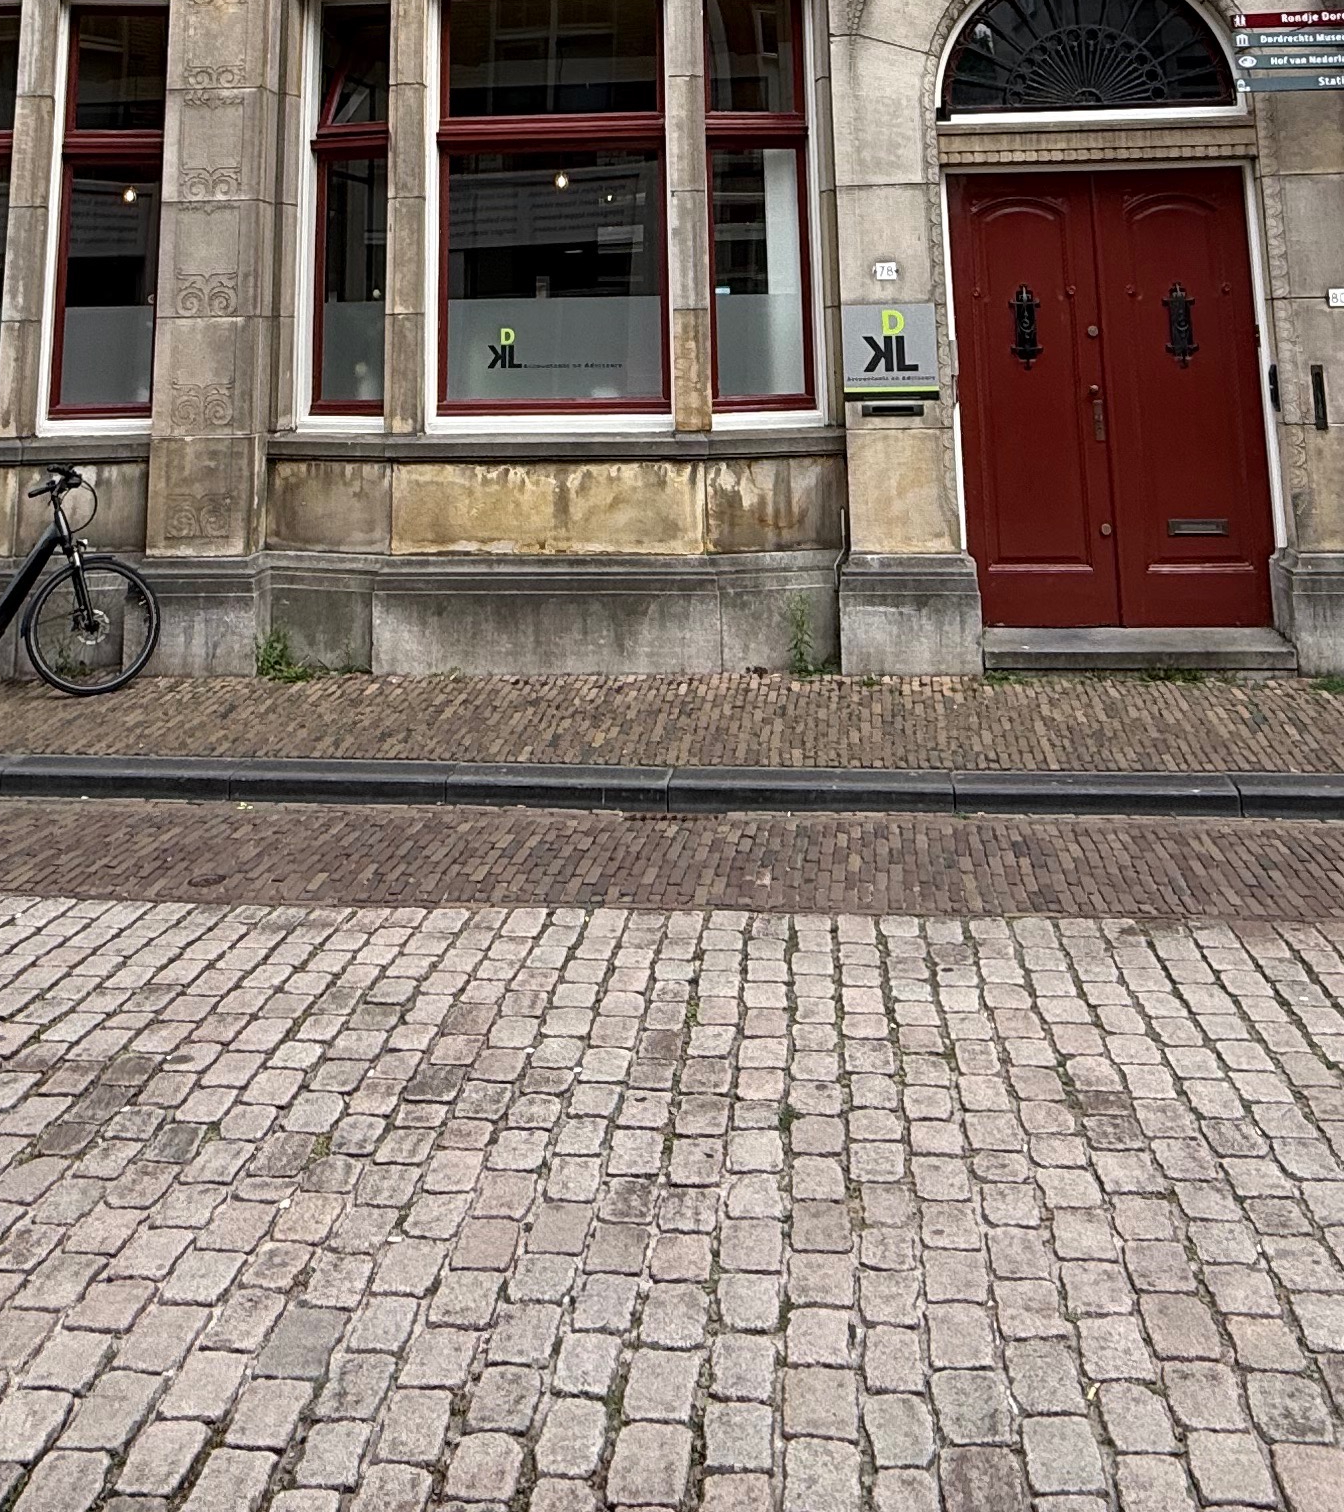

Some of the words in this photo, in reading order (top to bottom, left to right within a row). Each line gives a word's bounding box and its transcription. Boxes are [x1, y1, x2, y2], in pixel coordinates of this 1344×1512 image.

[1281, 12, 1319, 24] Rondje
[1260, 34, 1314, 43] Dordrechts
[1270, 56, 1288, 65] Hof
[879, 265, 894, 276] 78
[882, 309, 905, 335] D
[500, 328, 515, 345] D
